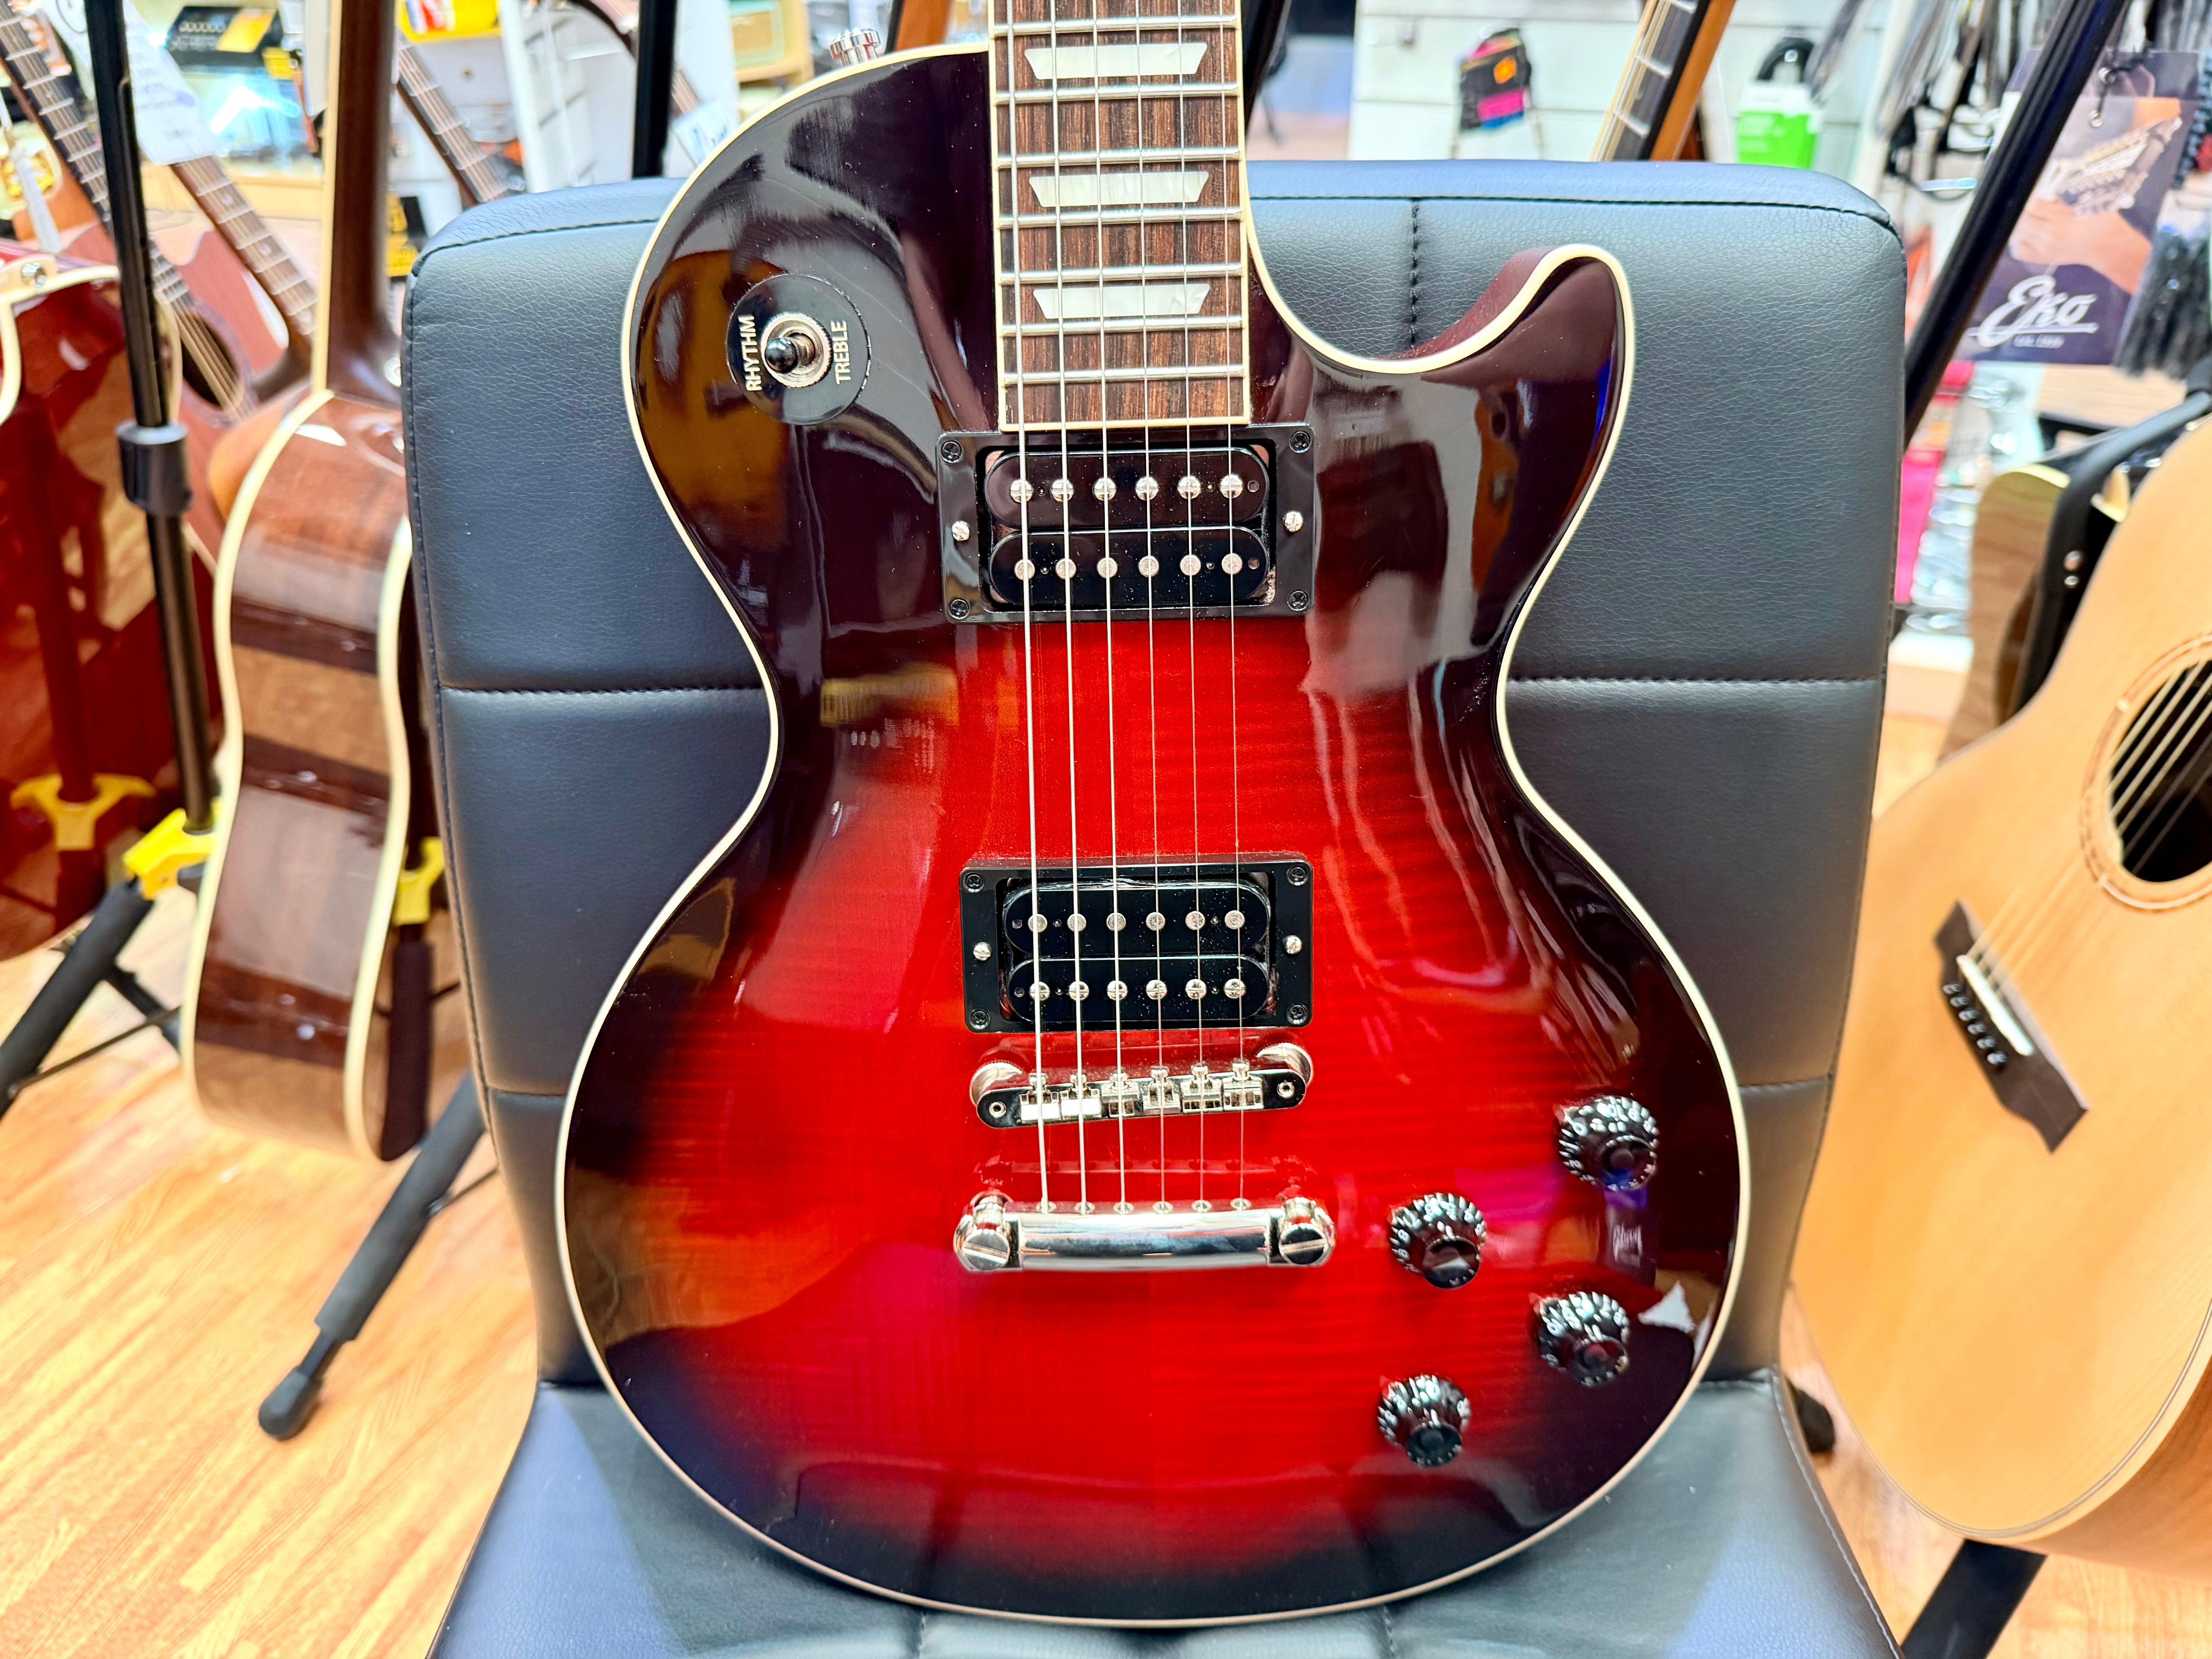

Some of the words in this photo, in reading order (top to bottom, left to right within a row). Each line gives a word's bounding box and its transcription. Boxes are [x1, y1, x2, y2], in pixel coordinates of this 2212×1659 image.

[1977, 275, 2097, 347] Eko
[738, 314, 762, 391] RHYTHM
[831, 320, 851, 385] TREBLE
[1398, 1229, 1411, 1244] 8
